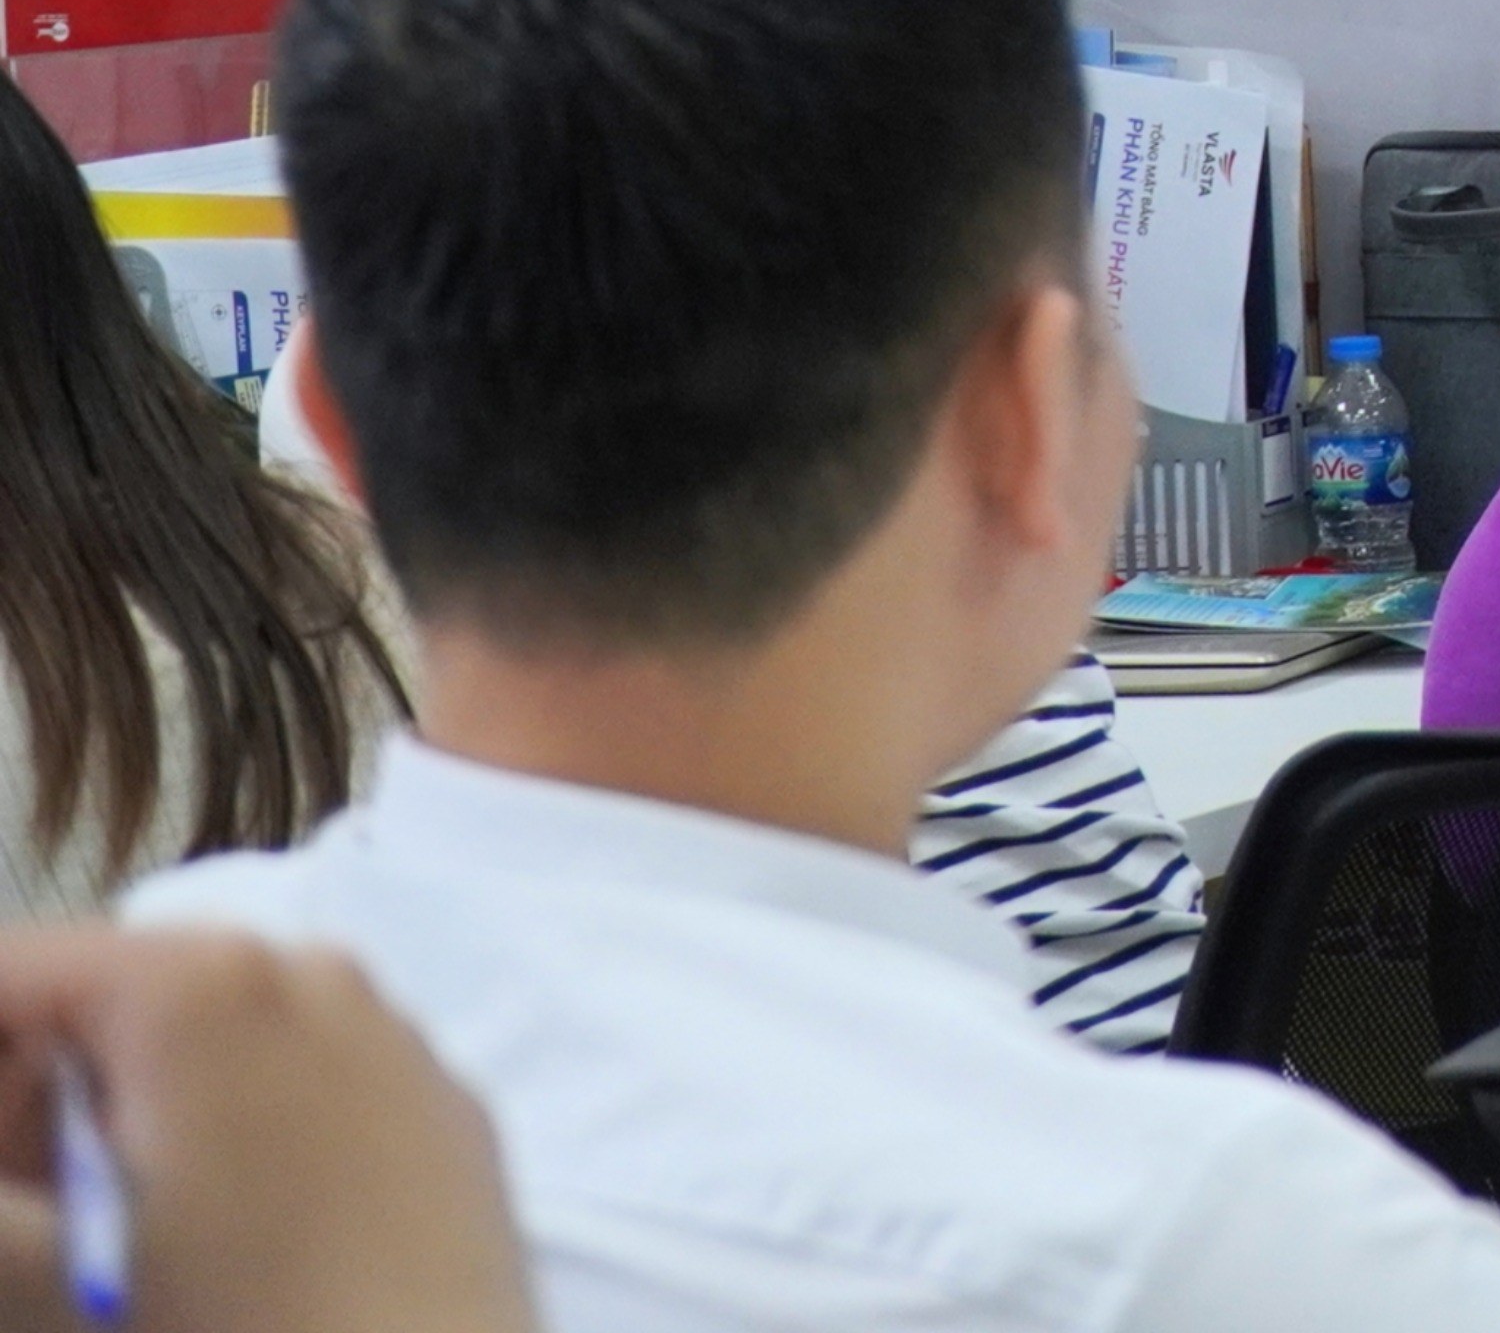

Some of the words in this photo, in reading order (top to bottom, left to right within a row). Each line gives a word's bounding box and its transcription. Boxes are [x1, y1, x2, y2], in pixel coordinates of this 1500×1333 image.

[1198, 131, 1221, 198] VLASTA
[1112, 187, 1135, 235] KHU
[1313, 455, 1364, 481] aVie
